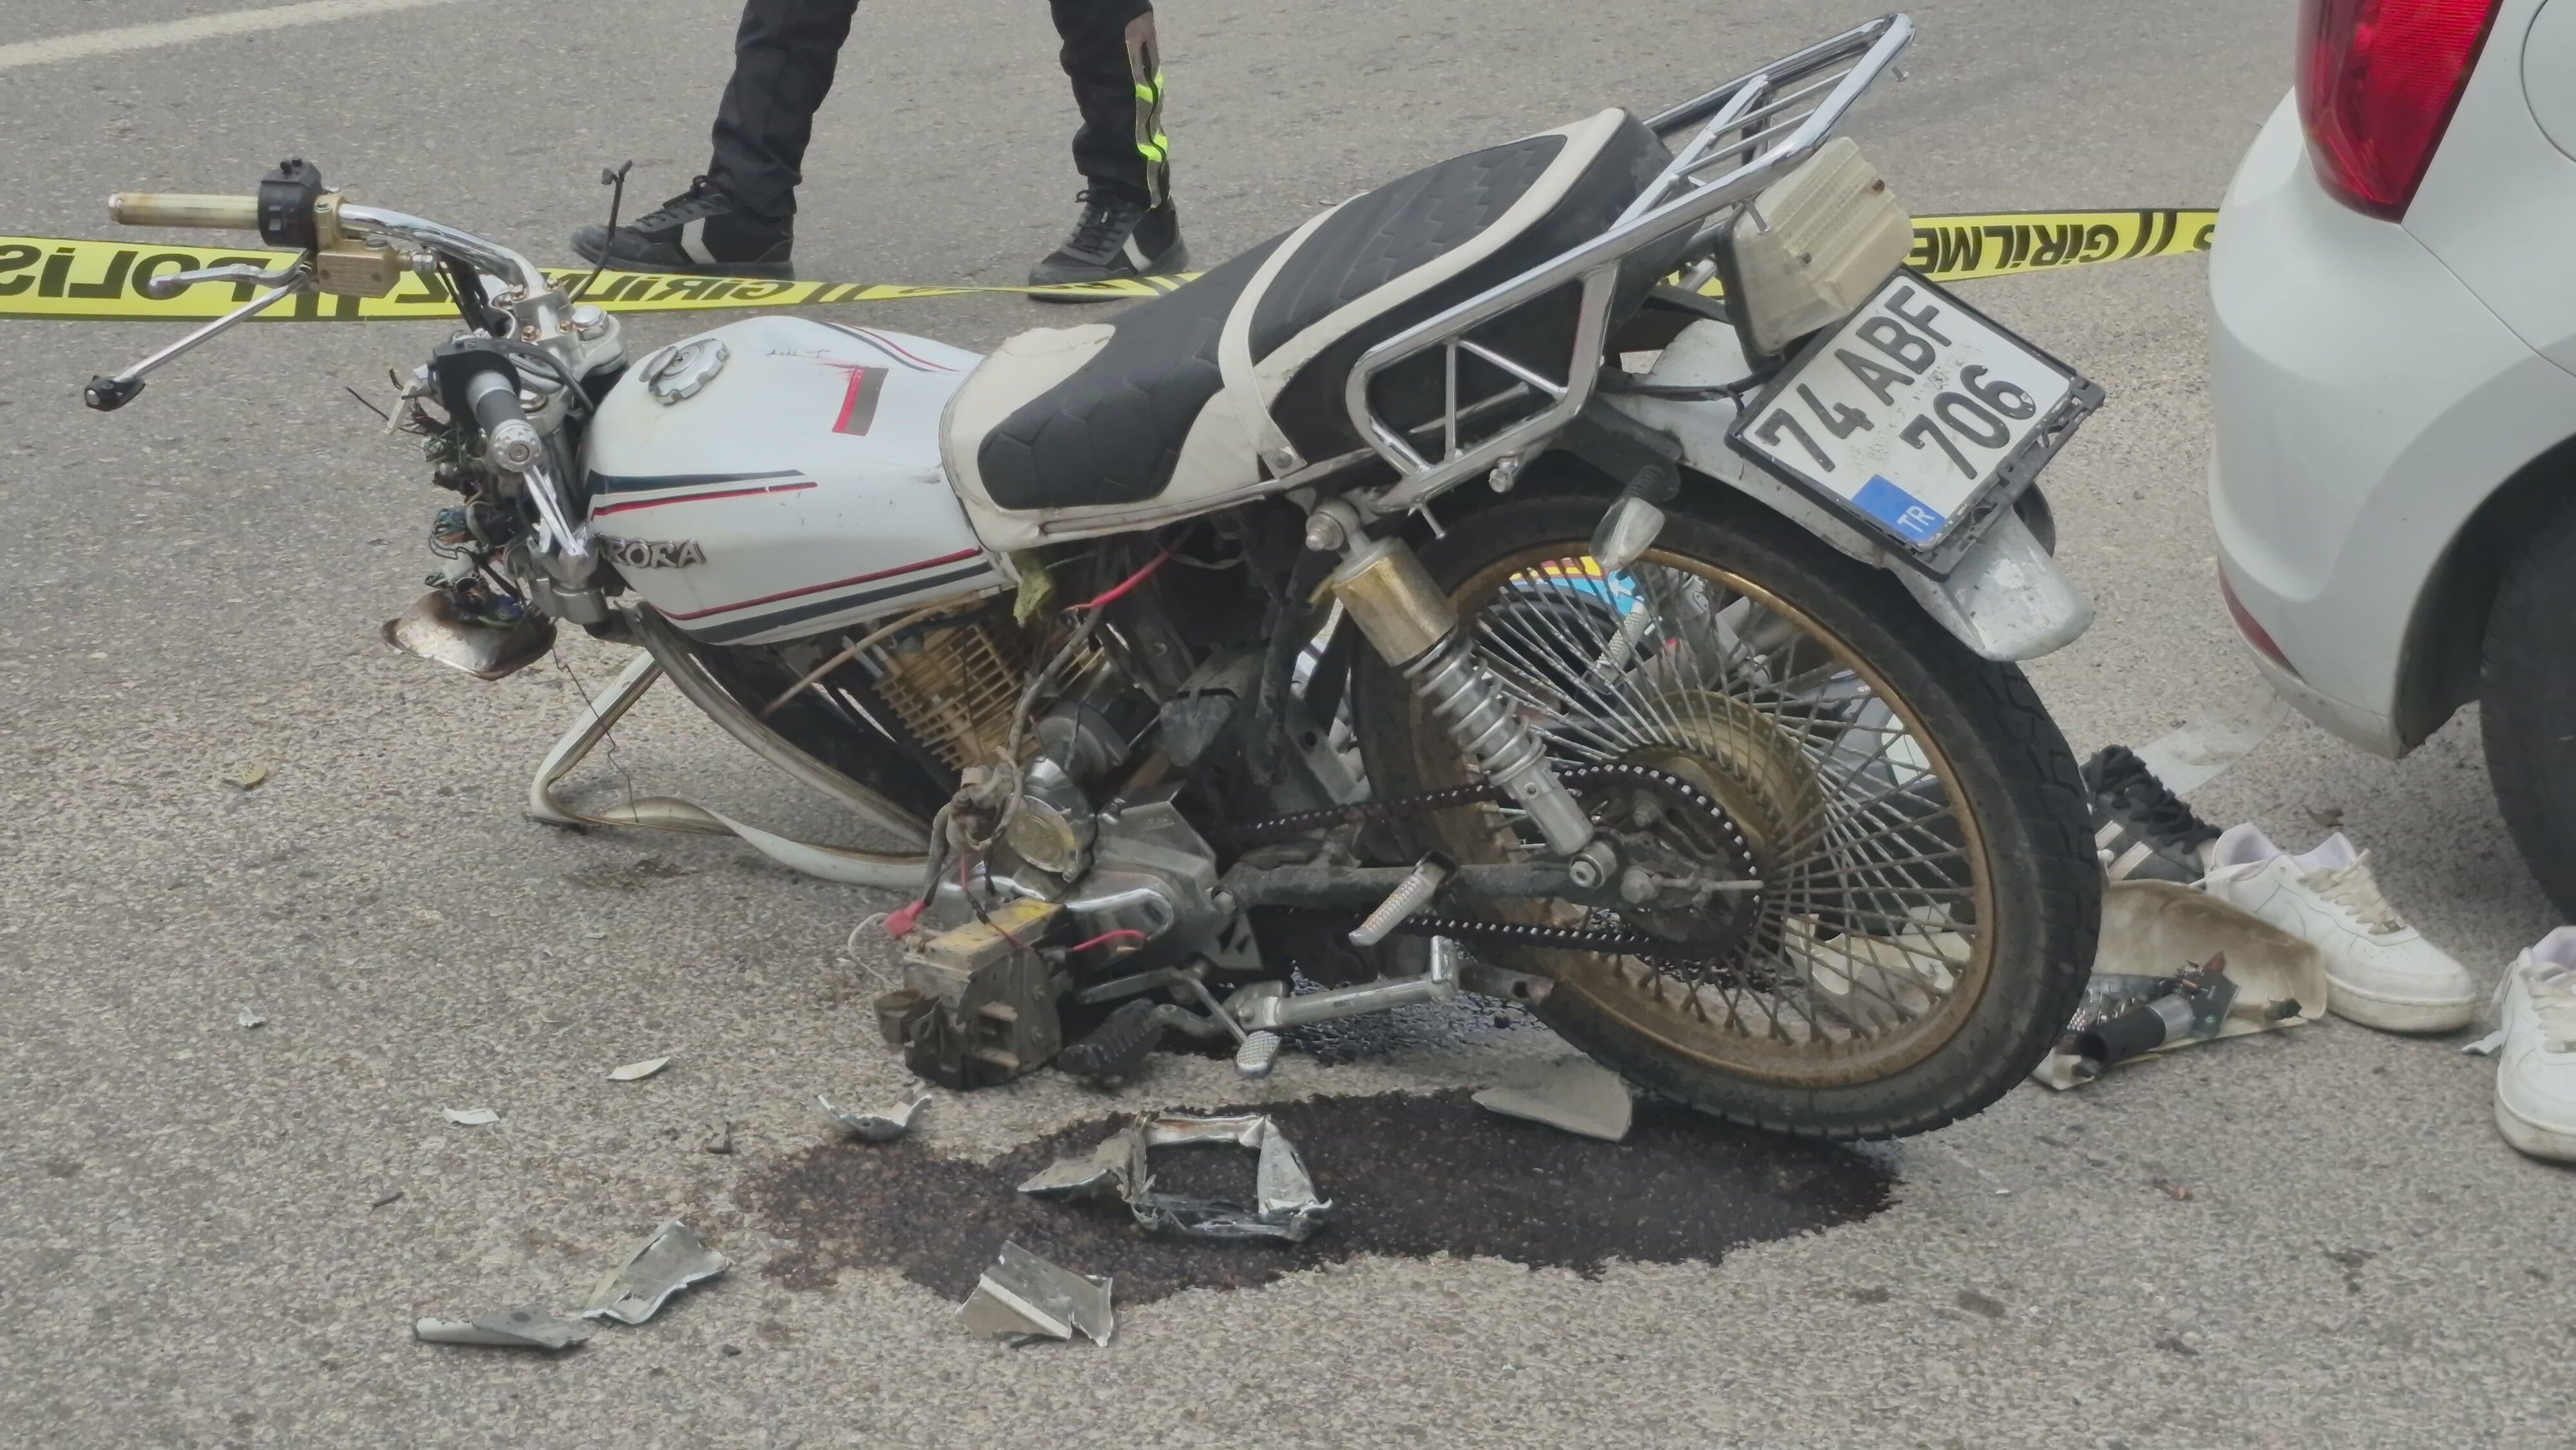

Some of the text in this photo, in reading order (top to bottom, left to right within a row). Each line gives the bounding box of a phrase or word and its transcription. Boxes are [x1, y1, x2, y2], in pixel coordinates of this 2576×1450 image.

[1756, 285, 1951, 473] 74 ABF
[1899, 364, 2036, 480] 706
[1897, 505, 1935, 534] TR
